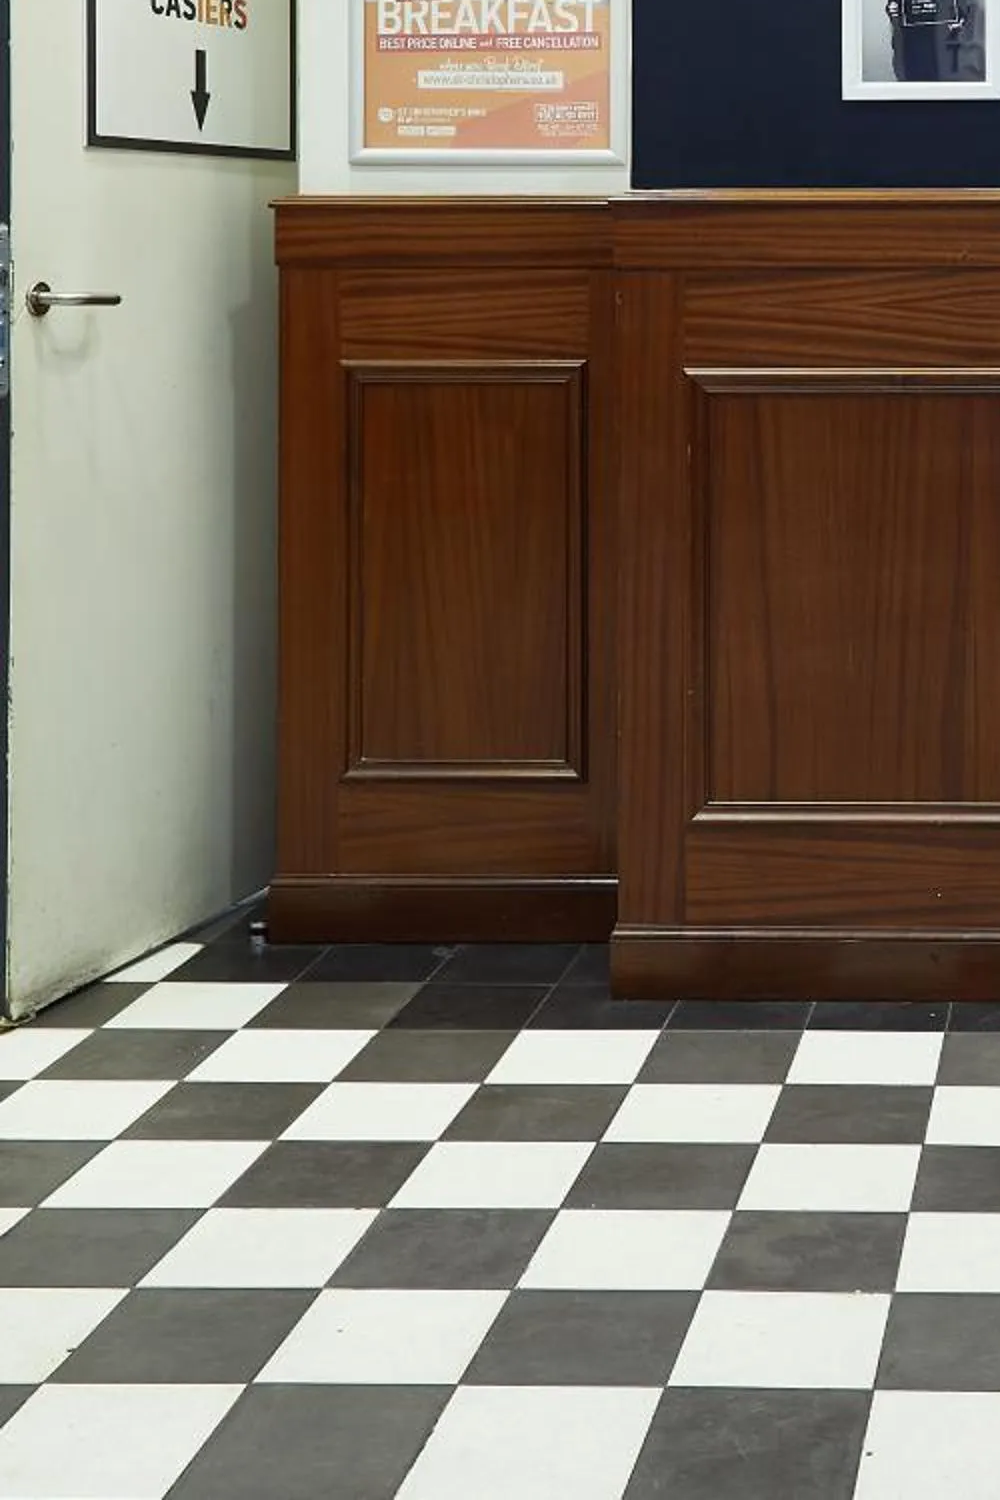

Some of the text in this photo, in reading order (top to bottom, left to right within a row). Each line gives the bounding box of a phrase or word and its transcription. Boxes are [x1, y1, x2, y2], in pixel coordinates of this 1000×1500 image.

[379, 37, 405, 49] BEST
[407, 37, 437, 49] PRICE
[440, 37, 476, 49] ONLINE
[496, 37, 523, 49] FREE
[523, 36, 600, 49] CANCELLATION
